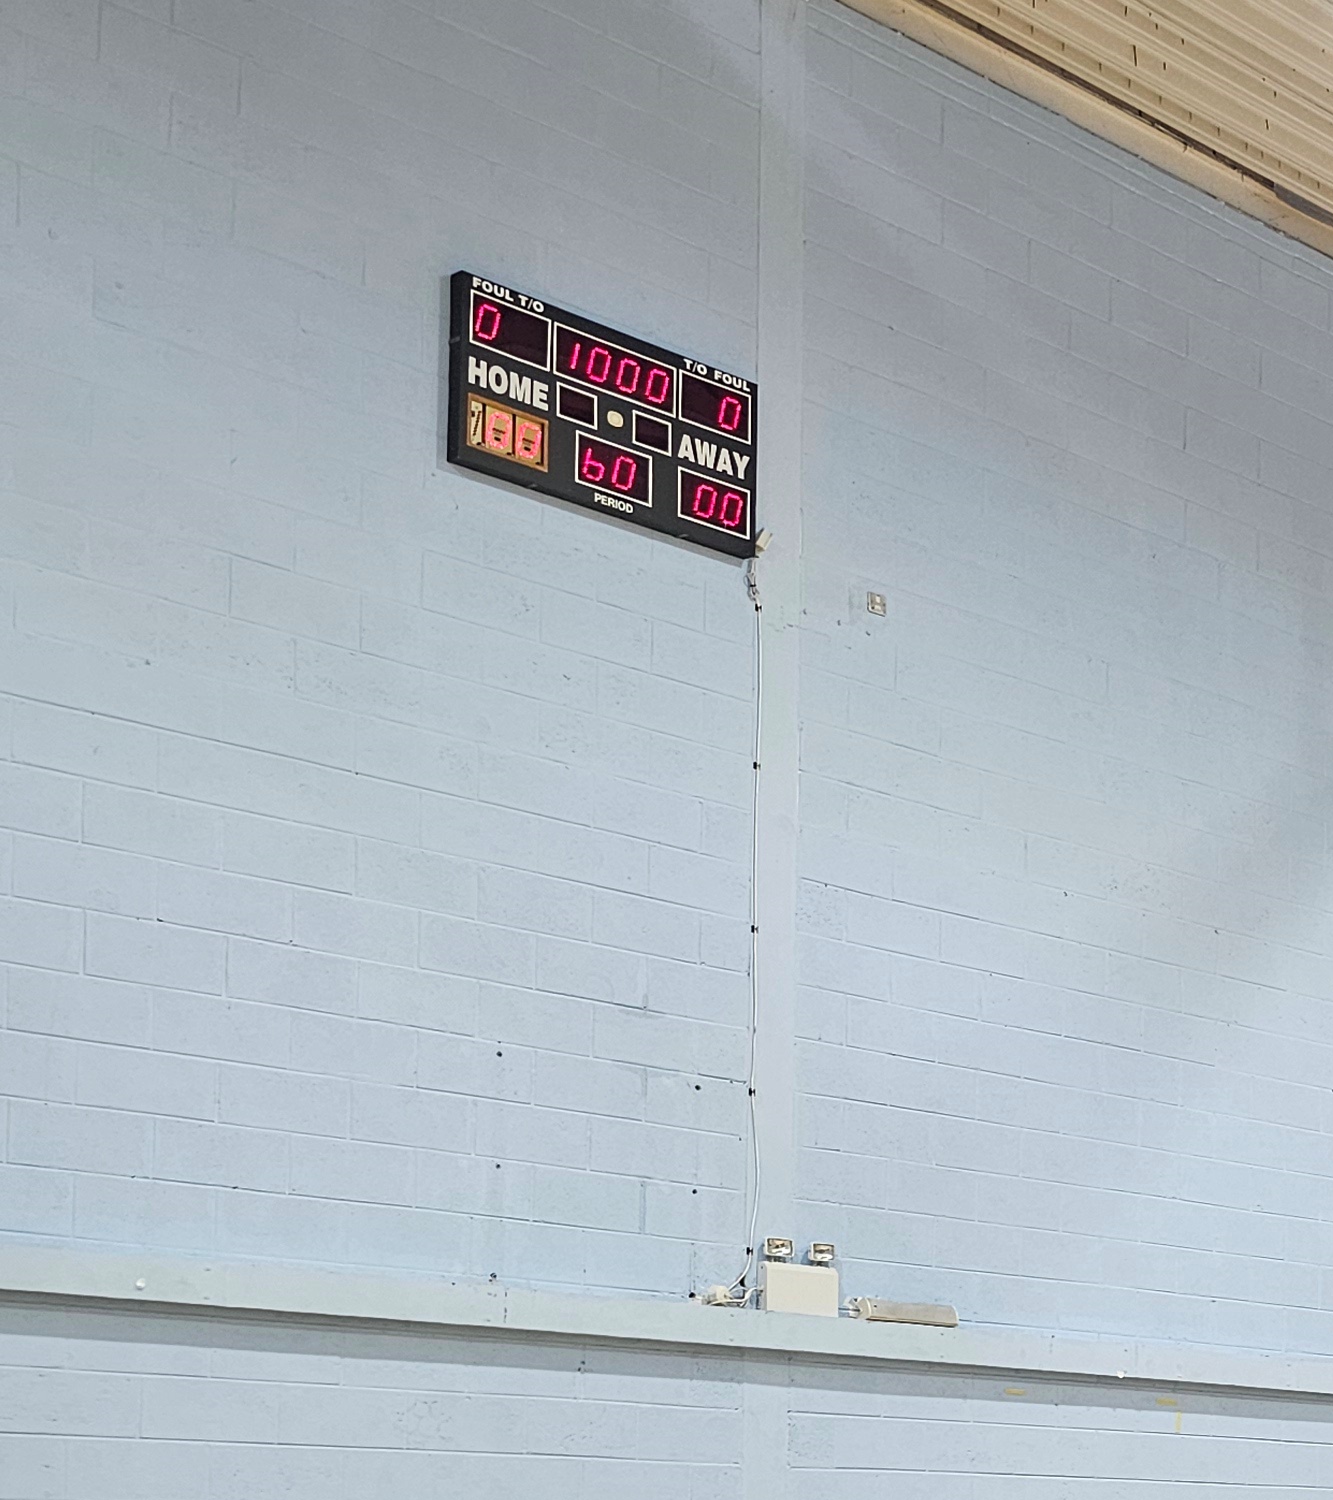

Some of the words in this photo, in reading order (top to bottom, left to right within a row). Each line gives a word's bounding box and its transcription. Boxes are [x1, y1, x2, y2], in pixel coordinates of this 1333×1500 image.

[472, 276, 514, 302] FOUL
[518, 294, 545, 313] T/O
[475, 303, 501, 340] 0
[468, 355, 549, 411] HOME
[570, 343, 670, 404] 1000
[683, 358, 708, 376] T/O
[714, 370, 751, 392] FOUL
[718, 396, 742, 431] 0
[677, 434, 750, 480] AWAY
[594, 492, 634, 514] PERIOD
[693, 484, 744, 527] 00
